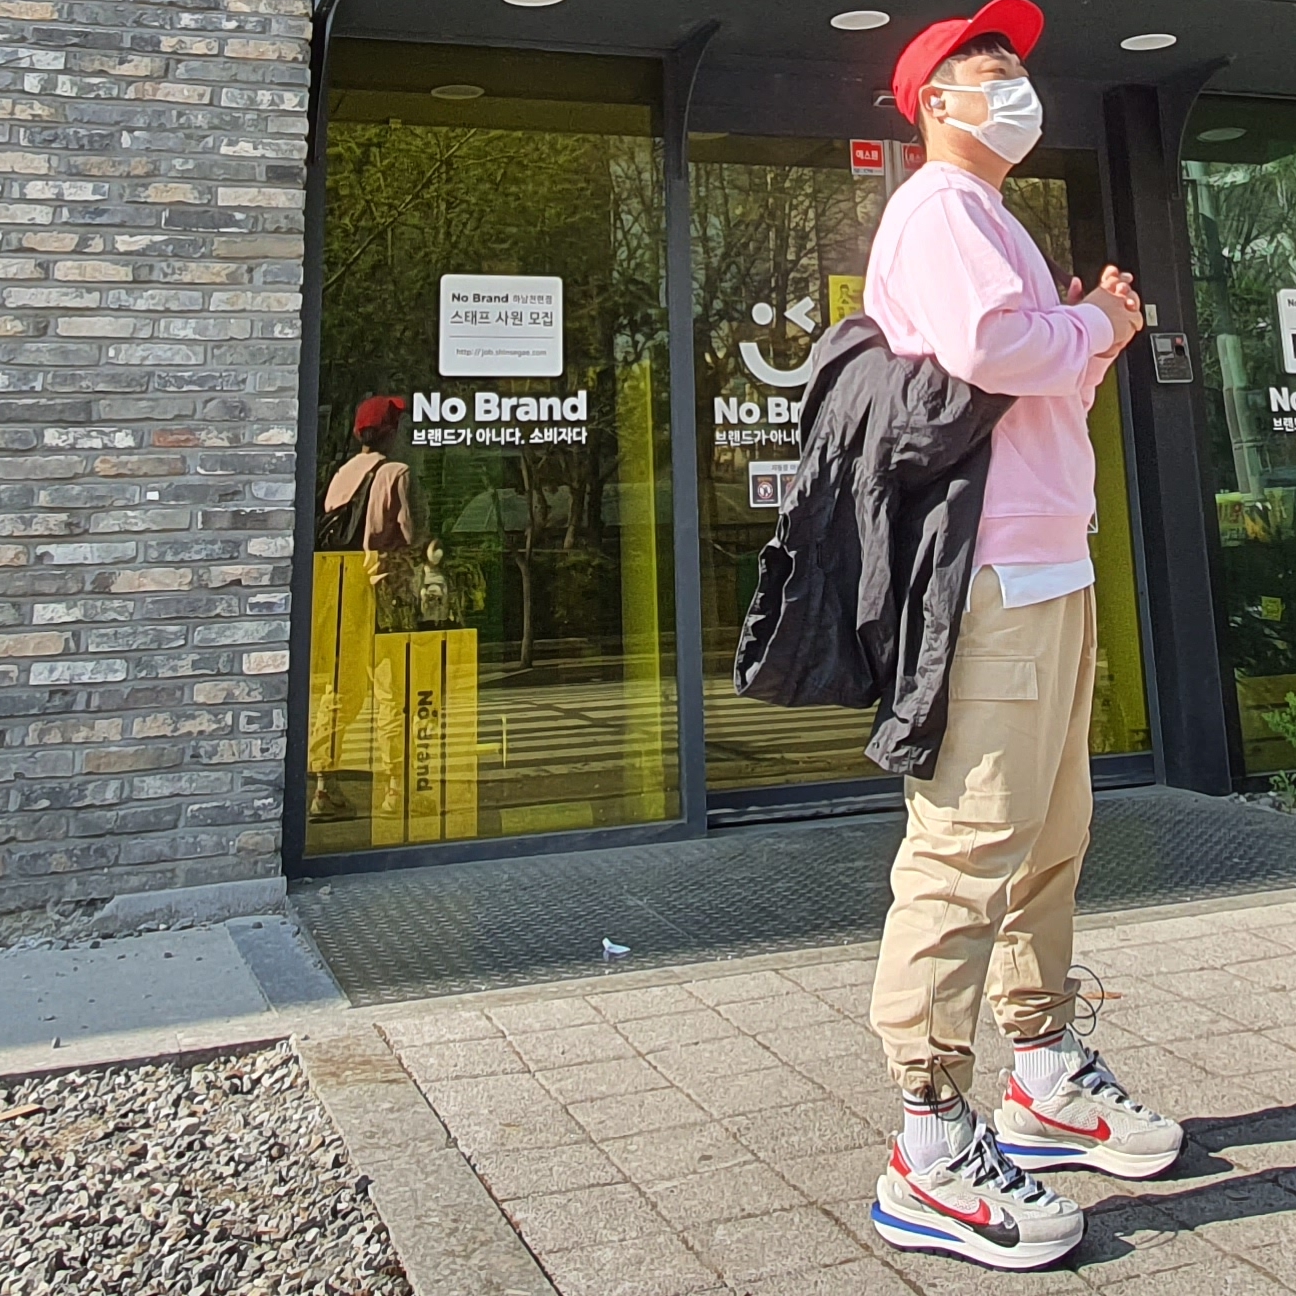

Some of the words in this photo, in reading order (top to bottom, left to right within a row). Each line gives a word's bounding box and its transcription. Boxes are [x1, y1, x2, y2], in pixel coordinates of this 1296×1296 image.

[451, 293, 469, 303] No
[472, 293, 509, 304] Brand
[450, 310, 491, 326] 스태프
[495, 310, 523, 326] 사원
[528, 311, 553, 327] 모집
[412, 392, 467, 422] No
[474, 390, 588, 422] Brand
[714, 396, 761, 424] No
[412, 428, 473, 447] 브랜드가
[475, 427, 525, 446] 아니다.
[529, 427, 588, 445] 소비자다
[714, 429, 768, 447] 브랜드가
[418, 689, 433, 719] No
[417, 728, 433, 792] Brand
